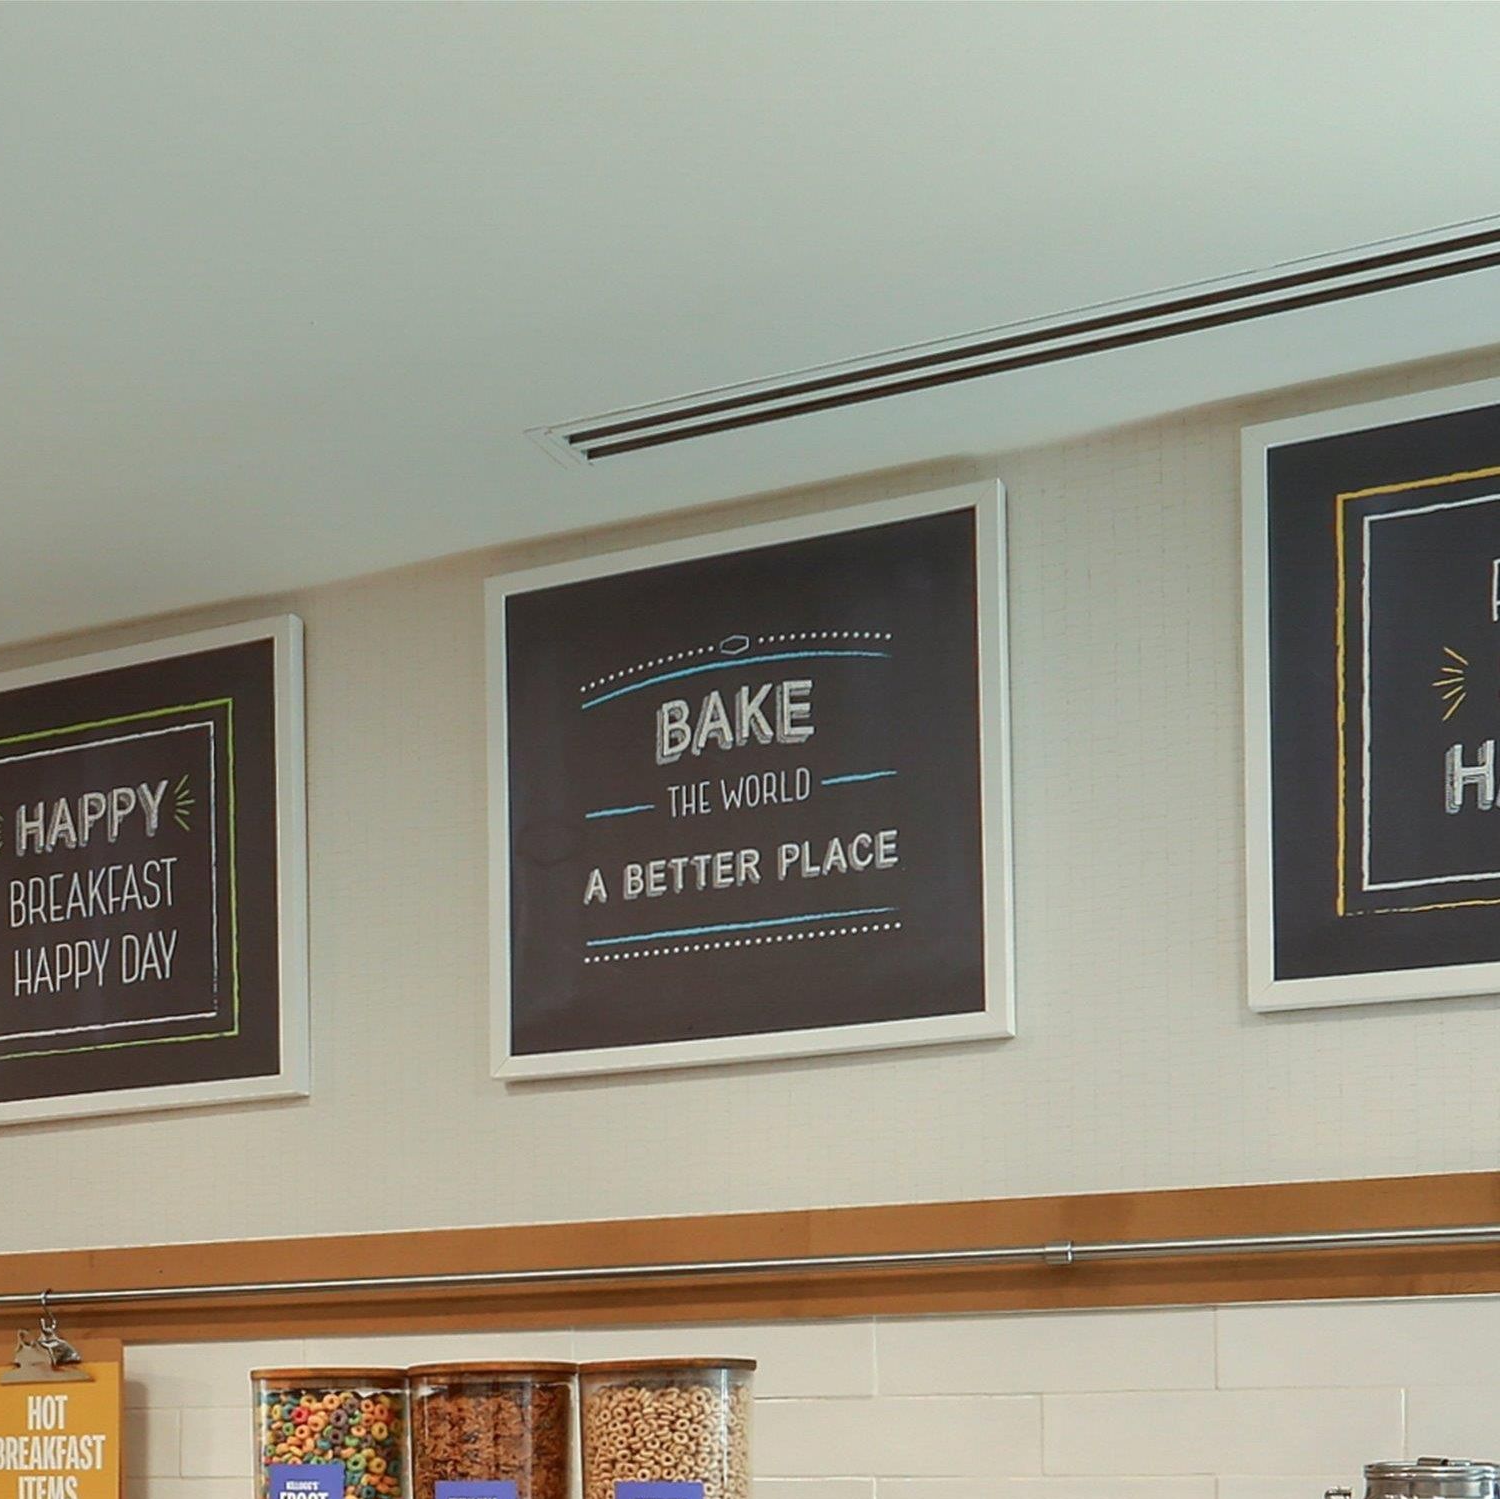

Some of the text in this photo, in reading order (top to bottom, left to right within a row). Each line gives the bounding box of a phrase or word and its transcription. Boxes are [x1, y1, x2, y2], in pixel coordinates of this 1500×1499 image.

[655, 679, 815, 765] BAKE
[15, 779, 168, 856] HAPPY
[667, 767, 812, 818] THE WORLD
[10, 857, 178, 928] BREAKFAST
[583, 829, 900, 905] A BETTER PLACE
[14, 929, 178, 997] HAPPY DAY
[27, 1395, 69, 1431] HOT
